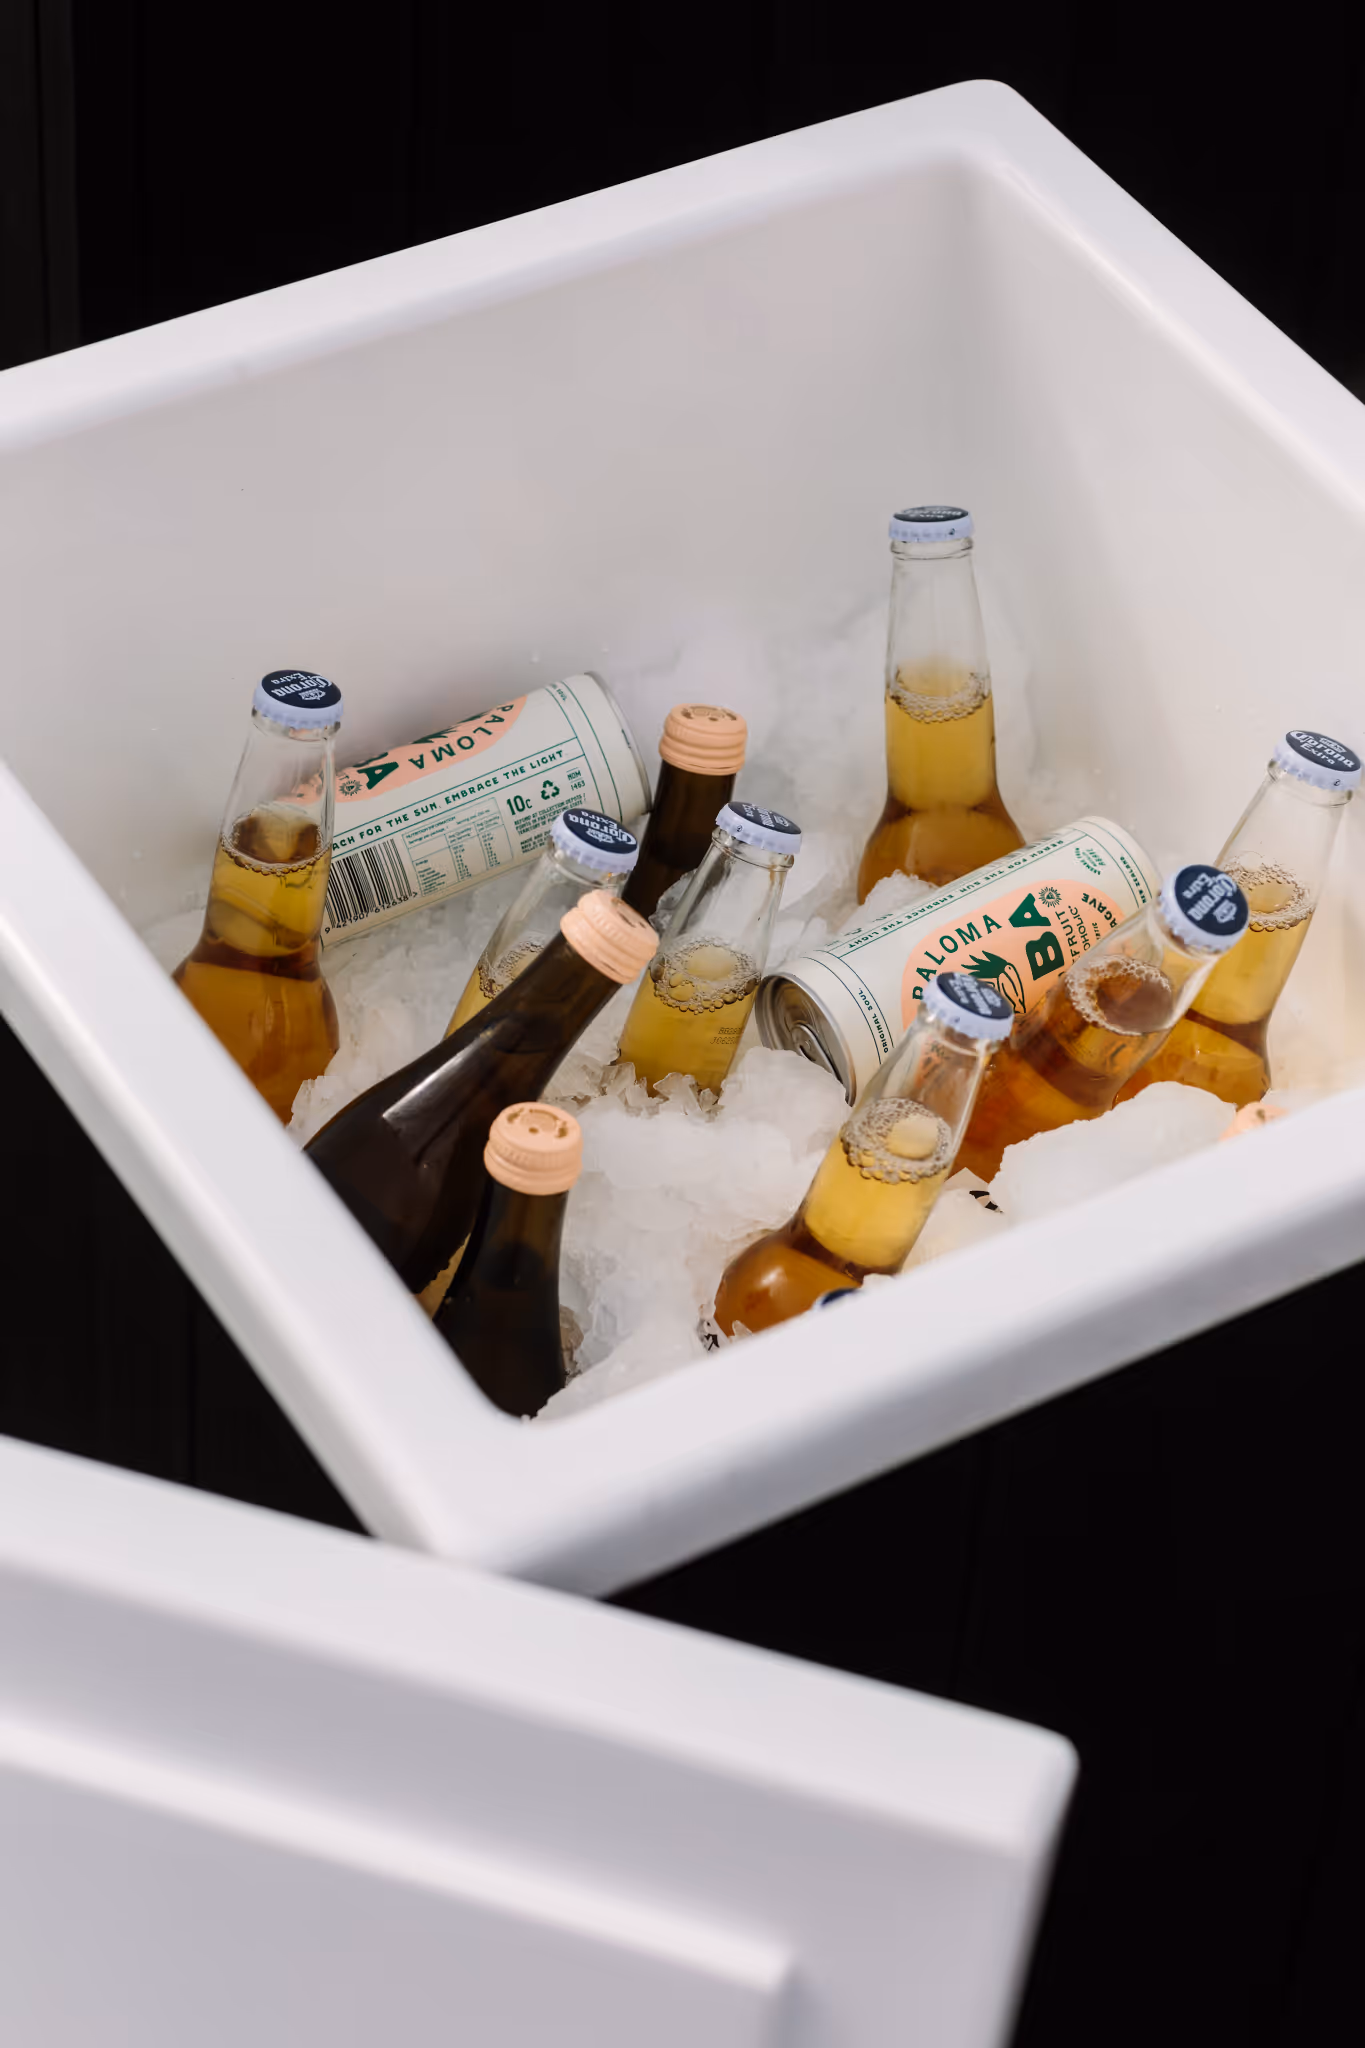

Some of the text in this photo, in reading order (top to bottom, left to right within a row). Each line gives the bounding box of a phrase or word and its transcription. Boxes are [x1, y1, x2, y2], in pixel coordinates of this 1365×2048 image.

[271, 672, 307, 684] Extra
[271, 675, 332, 697] Corona
[408, 703, 515, 770] PALOMA
[1290, 730, 1355, 768] Corona
[1300, 743, 1336, 765] Extra
[332, 836, 355, 851] ACH
[359, 825, 382, 840] FOR
[386, 813, 410, 828] THE
[444, 776, 500, 805] EMBRACE
[503, 766, 526, 780] THE
[506, 795, 533, 816] 10c
[581, 810, 618, 830] Extra
[567, 813, 637, 845] Corona
[983, 870, 1005, 881] THE
[904, 894, 954, 920] EMBRACE
[1081, 892, 1118, 929] AGAVE
[1187, 872, 1238, 921] Corona
[881, 920, 903, 931] THE
[1055, 911, 1081, 962] FRUIT
[912, 914, 1003, 1001] PALOMA
[872, 1012, 889, 1054] ORIGINAL
